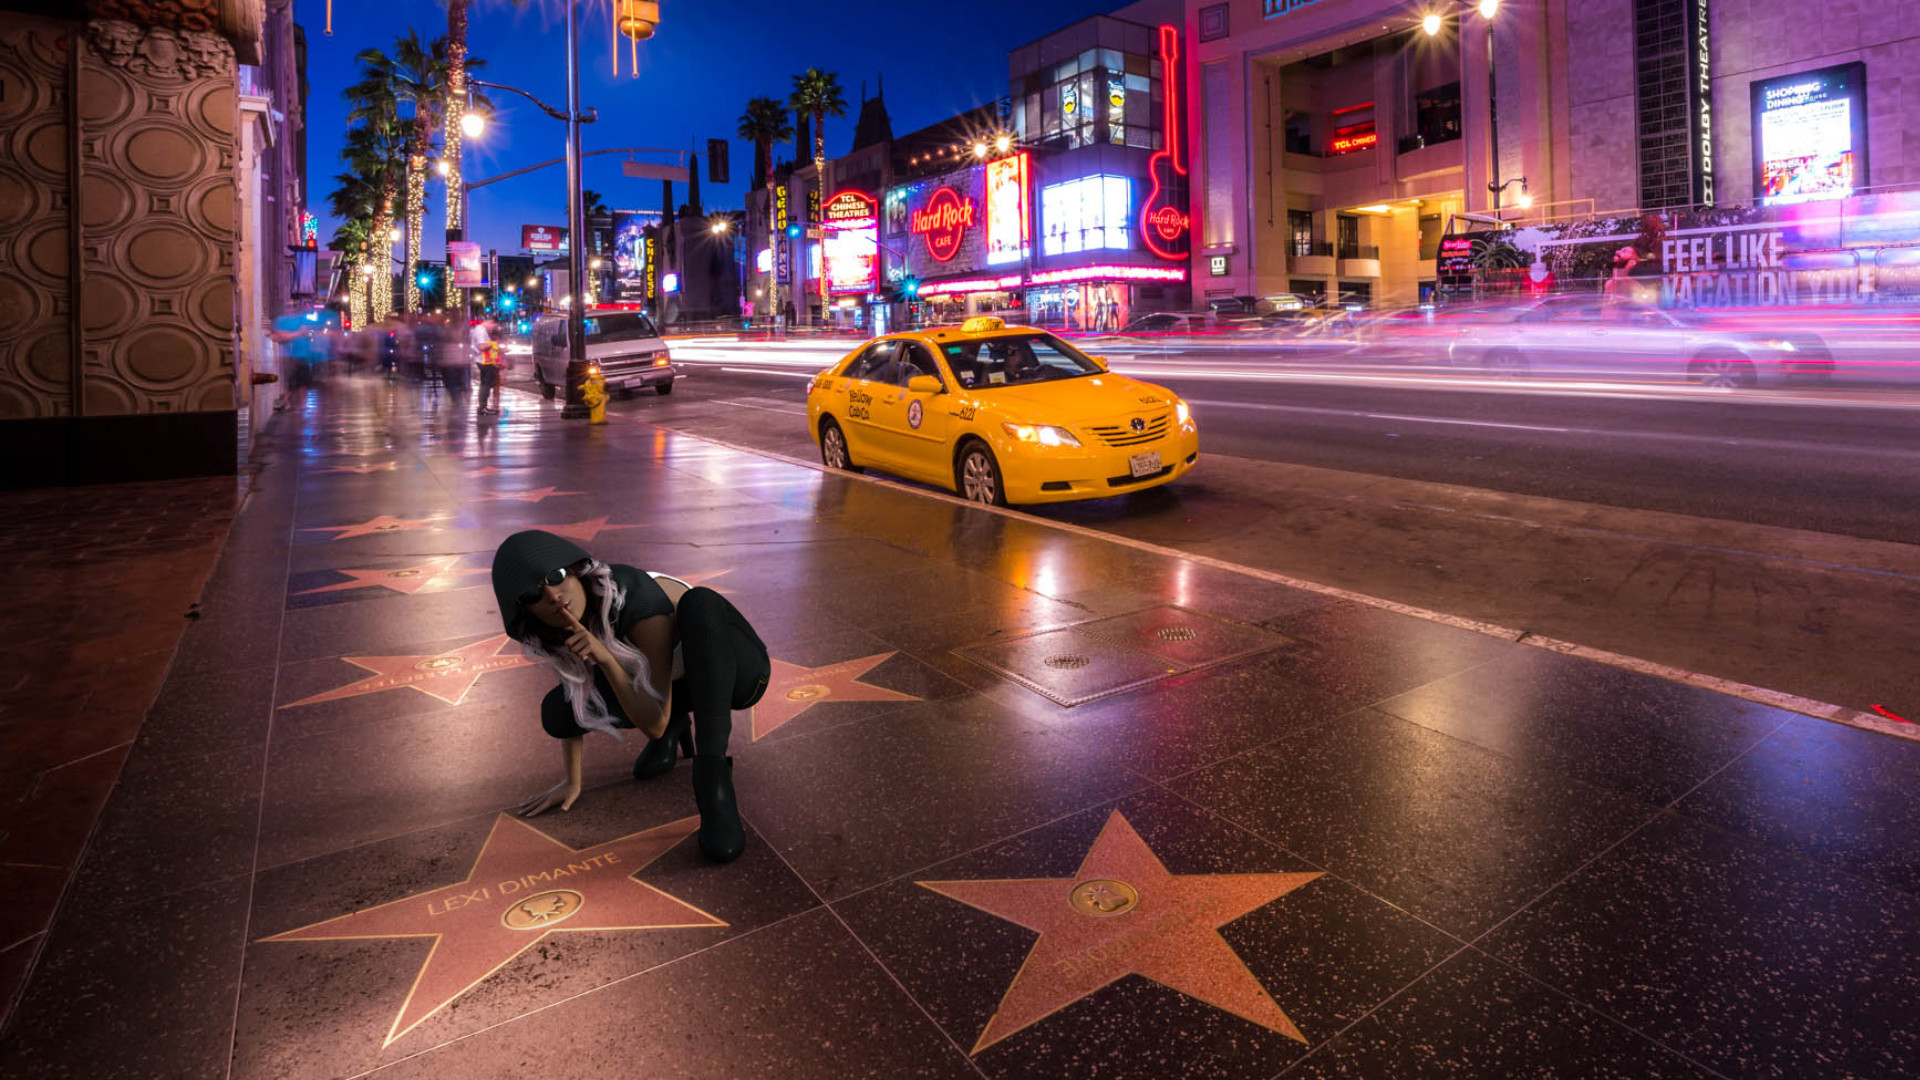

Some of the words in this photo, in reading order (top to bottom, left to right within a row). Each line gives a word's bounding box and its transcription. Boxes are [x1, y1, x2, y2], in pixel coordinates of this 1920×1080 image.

[1334, 140, 1352, 150] TCL
[1700, 98, 1713, 174] DOLBY
[830, 201, 866, 211] CHINESE
[840, 195, 856, 203] TCL
[827, 208, 871, 220] THEATRES
[912, 204, 941, 234] Hard
[942, 196, 974, 231] Rock
[1149, 211, 1171, 226] Hard
[1170, 214, 1190, 230] Rock
[934, 235, 952, 249] CAFE
[1662, 236, 1719, 273] FEEL
[1726, 231, 1784, 269] LIKE
[645, 238, 655, 299] CHINESE
[1662, 270, 1798, 310] VACATION
[849, 389, 873, 407] Yellow
[427, 888, 491, 917] LEXI
[498, 851, 623, 895] DIMANTE
